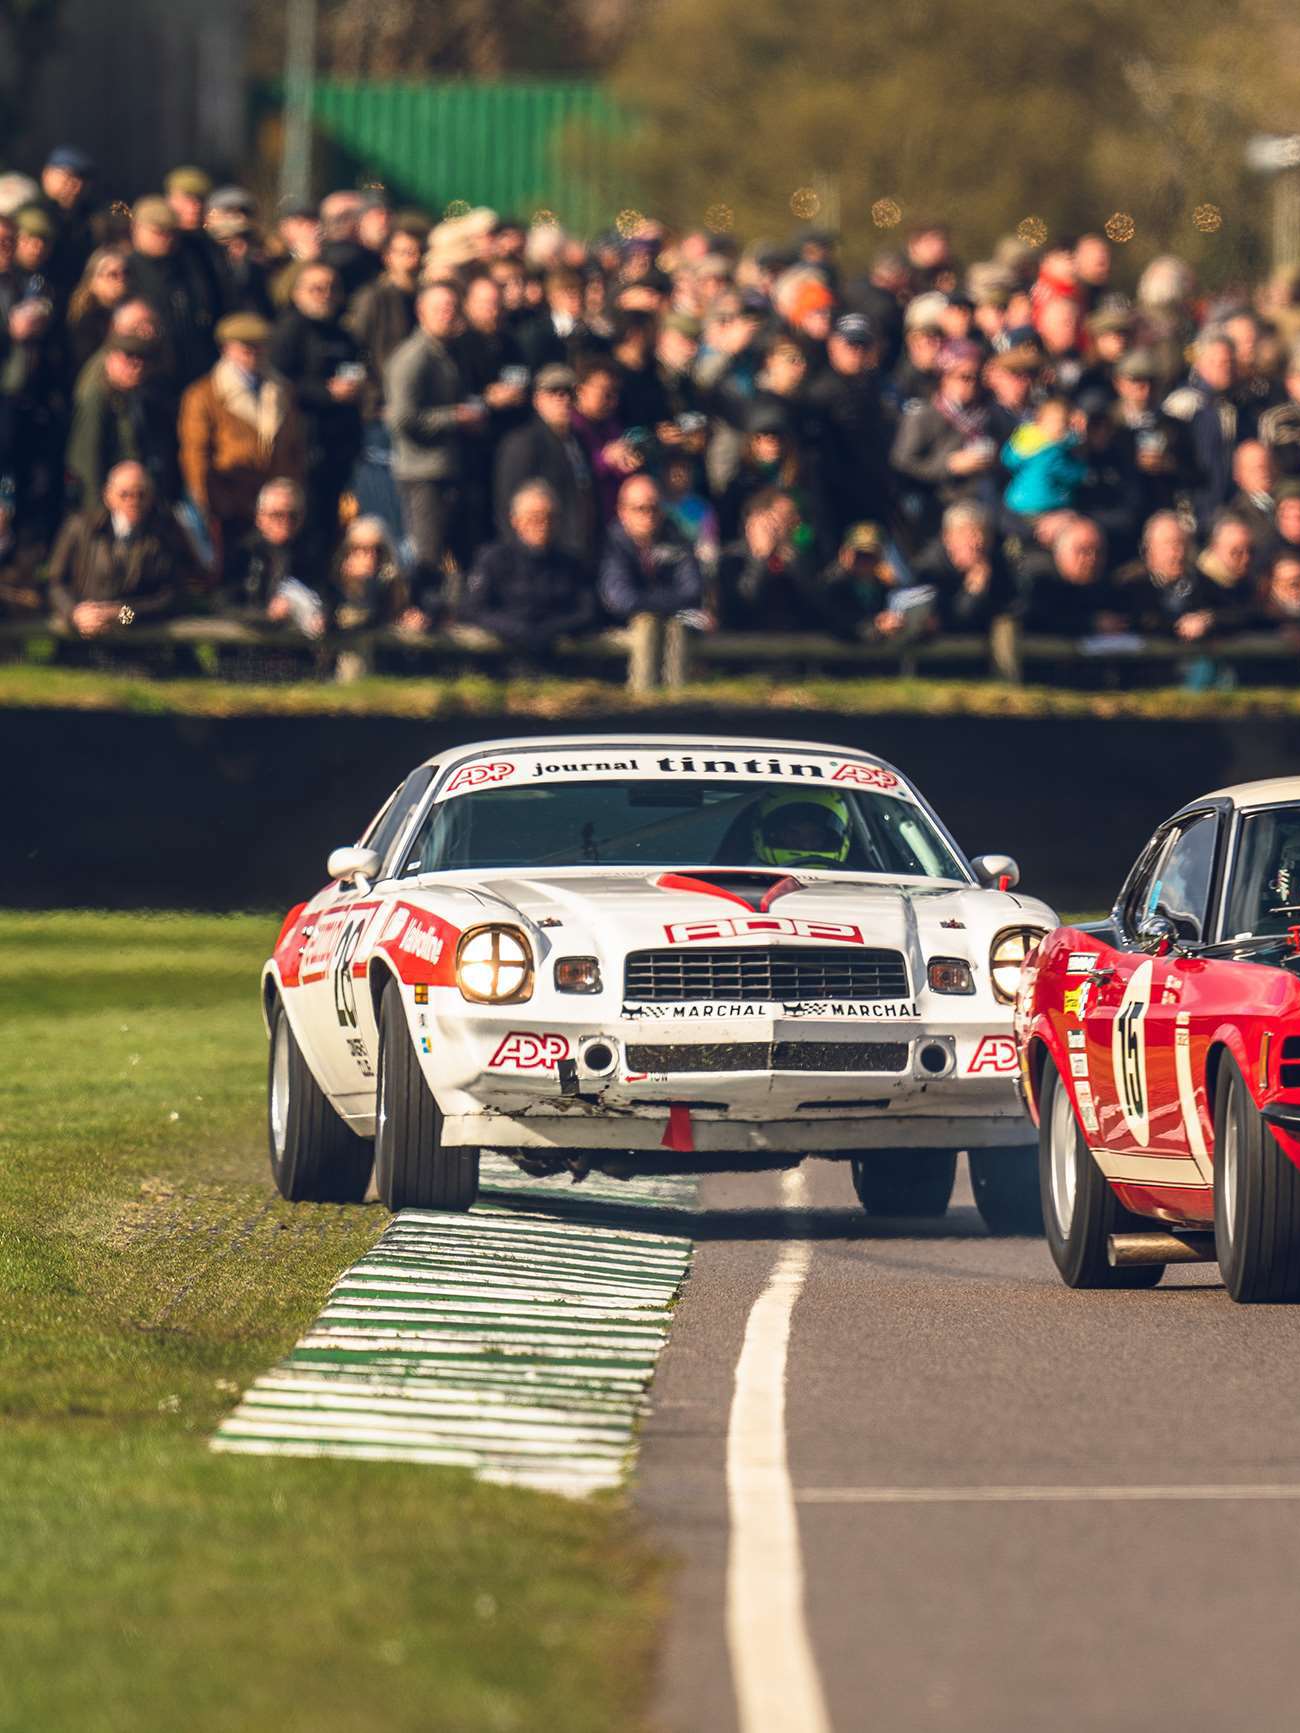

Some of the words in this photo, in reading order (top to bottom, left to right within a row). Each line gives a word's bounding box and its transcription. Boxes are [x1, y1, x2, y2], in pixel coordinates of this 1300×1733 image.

[446, 761, 516, 792] ADP
[532, 759, 639, 777] journal
[656, 756, 825, 778] tintin
[831, 763, 900, 789] ADP
[663, 917, 865, 944] ADP
[672, 1003, 767, 1018] MARCHAL
[831, 1002, 922, 1018] MARCHAL
[489, 1031, 570, 1068] ADP
[967, 1034, 1019, 1073] AD
[1117, 1000, 1146, 1119] 15
